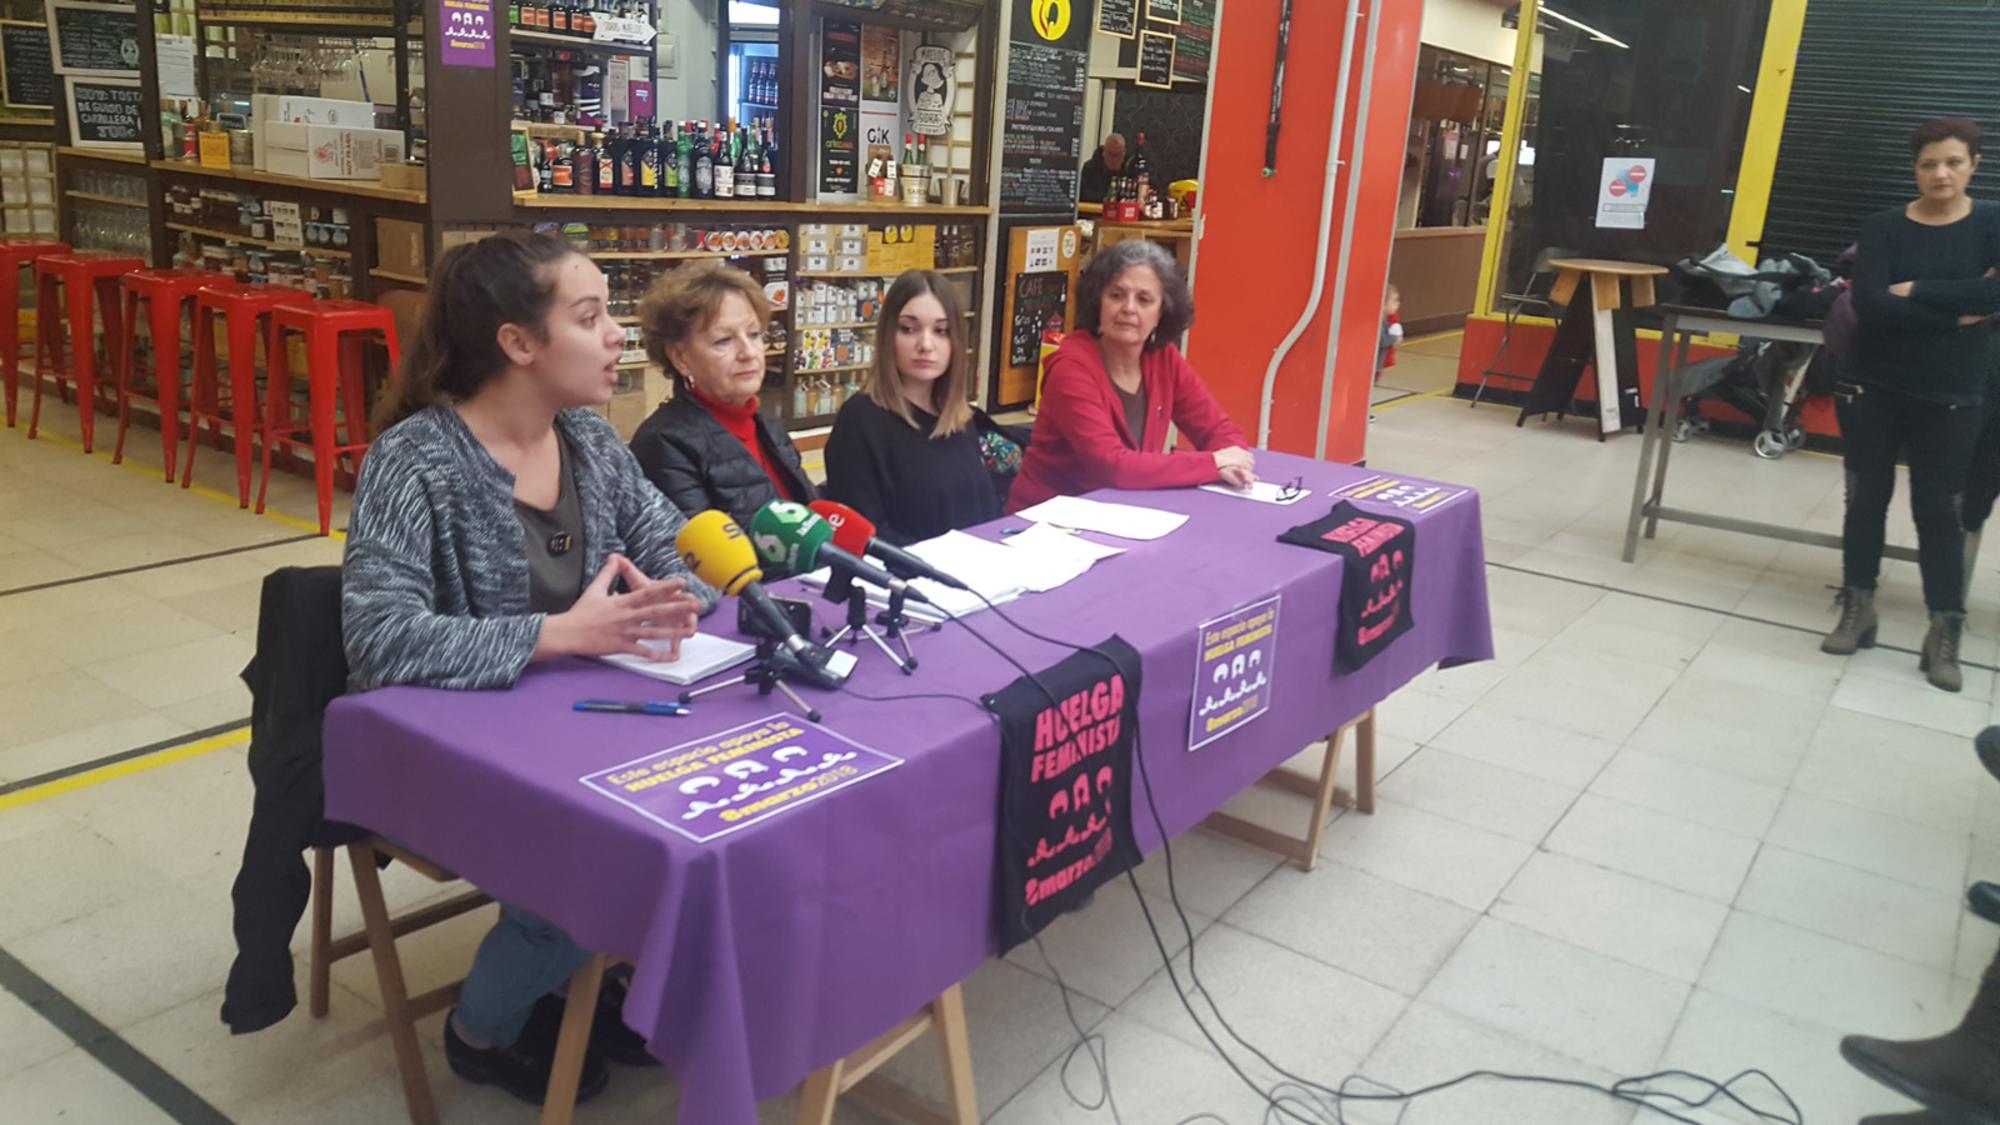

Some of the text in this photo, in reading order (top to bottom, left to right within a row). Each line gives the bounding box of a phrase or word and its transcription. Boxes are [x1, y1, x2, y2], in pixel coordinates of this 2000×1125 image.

[1034, 673, 1125, 752] HUELGA
[605, 720, 791, 786] Este espacio apoya la
[624, 727, 806, 792] HUELGA FEMINISTA
[719, 765, 859, 822] 8marzo2018
